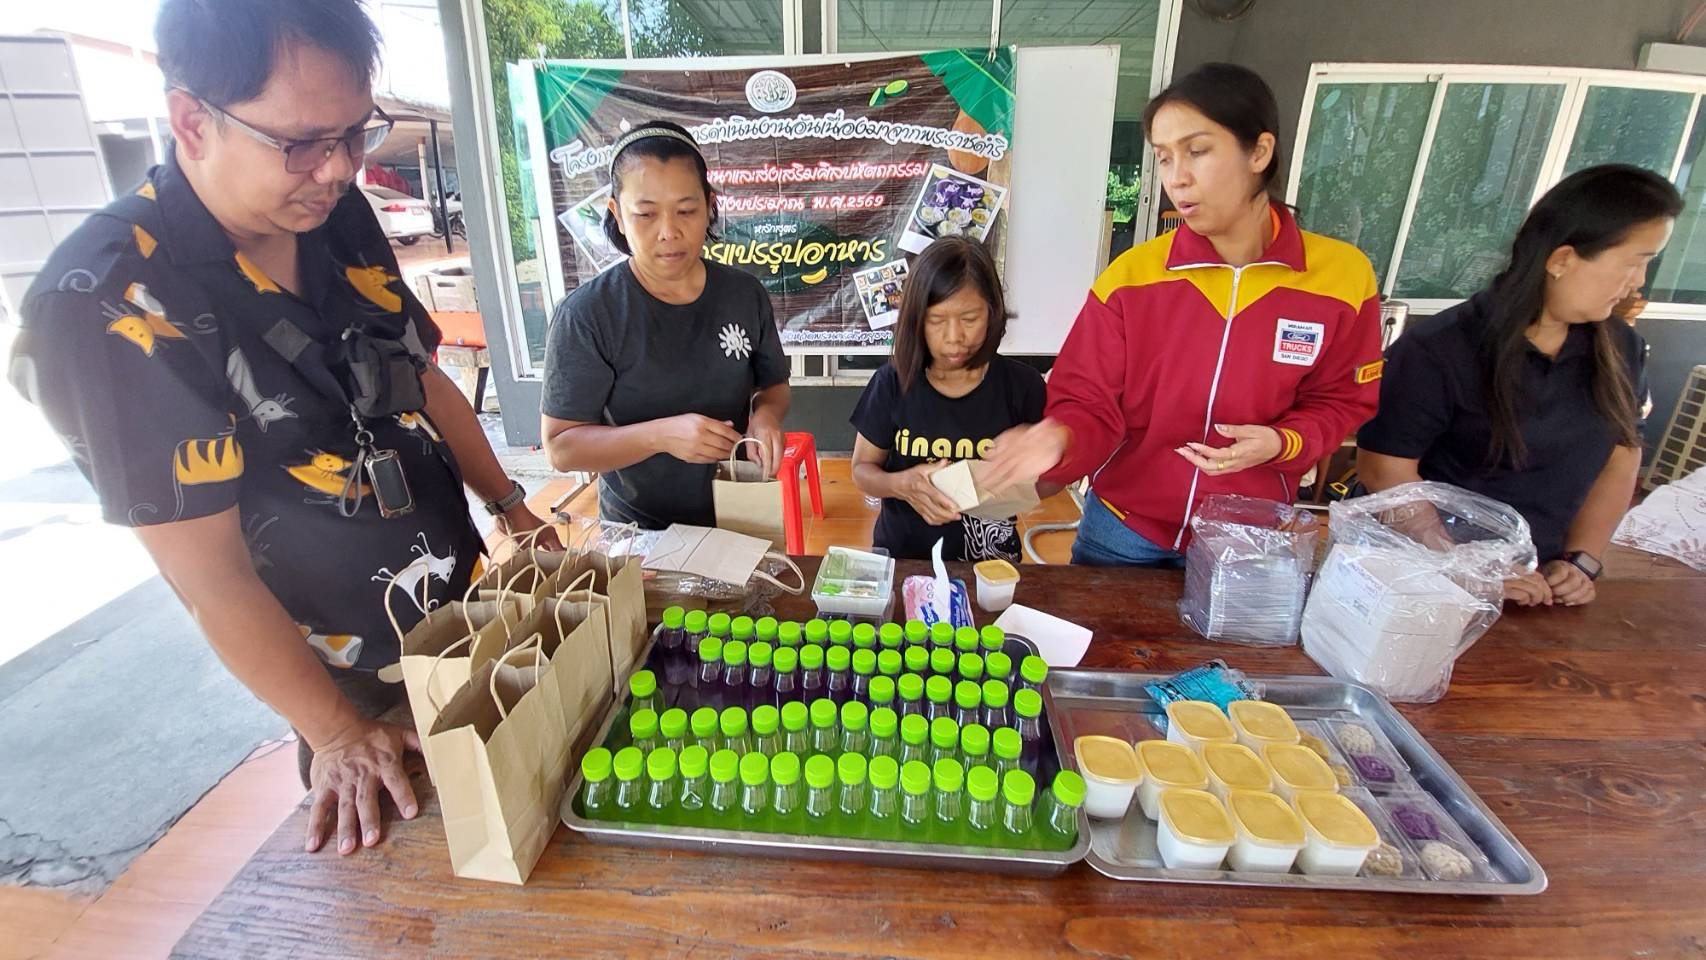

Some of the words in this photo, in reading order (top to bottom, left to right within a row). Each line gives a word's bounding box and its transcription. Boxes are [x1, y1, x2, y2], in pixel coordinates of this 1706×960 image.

[691, 110, 1007, 159] ารดำเนินงานอันเนื่องมาจากพระราชดำริ
[812, 193, 884, 210] พ.ศ.2569
[701, 239, 887, 274] ารแปรรูปอาหาร
[1281, 342, 1313, 353] TRUCKS
